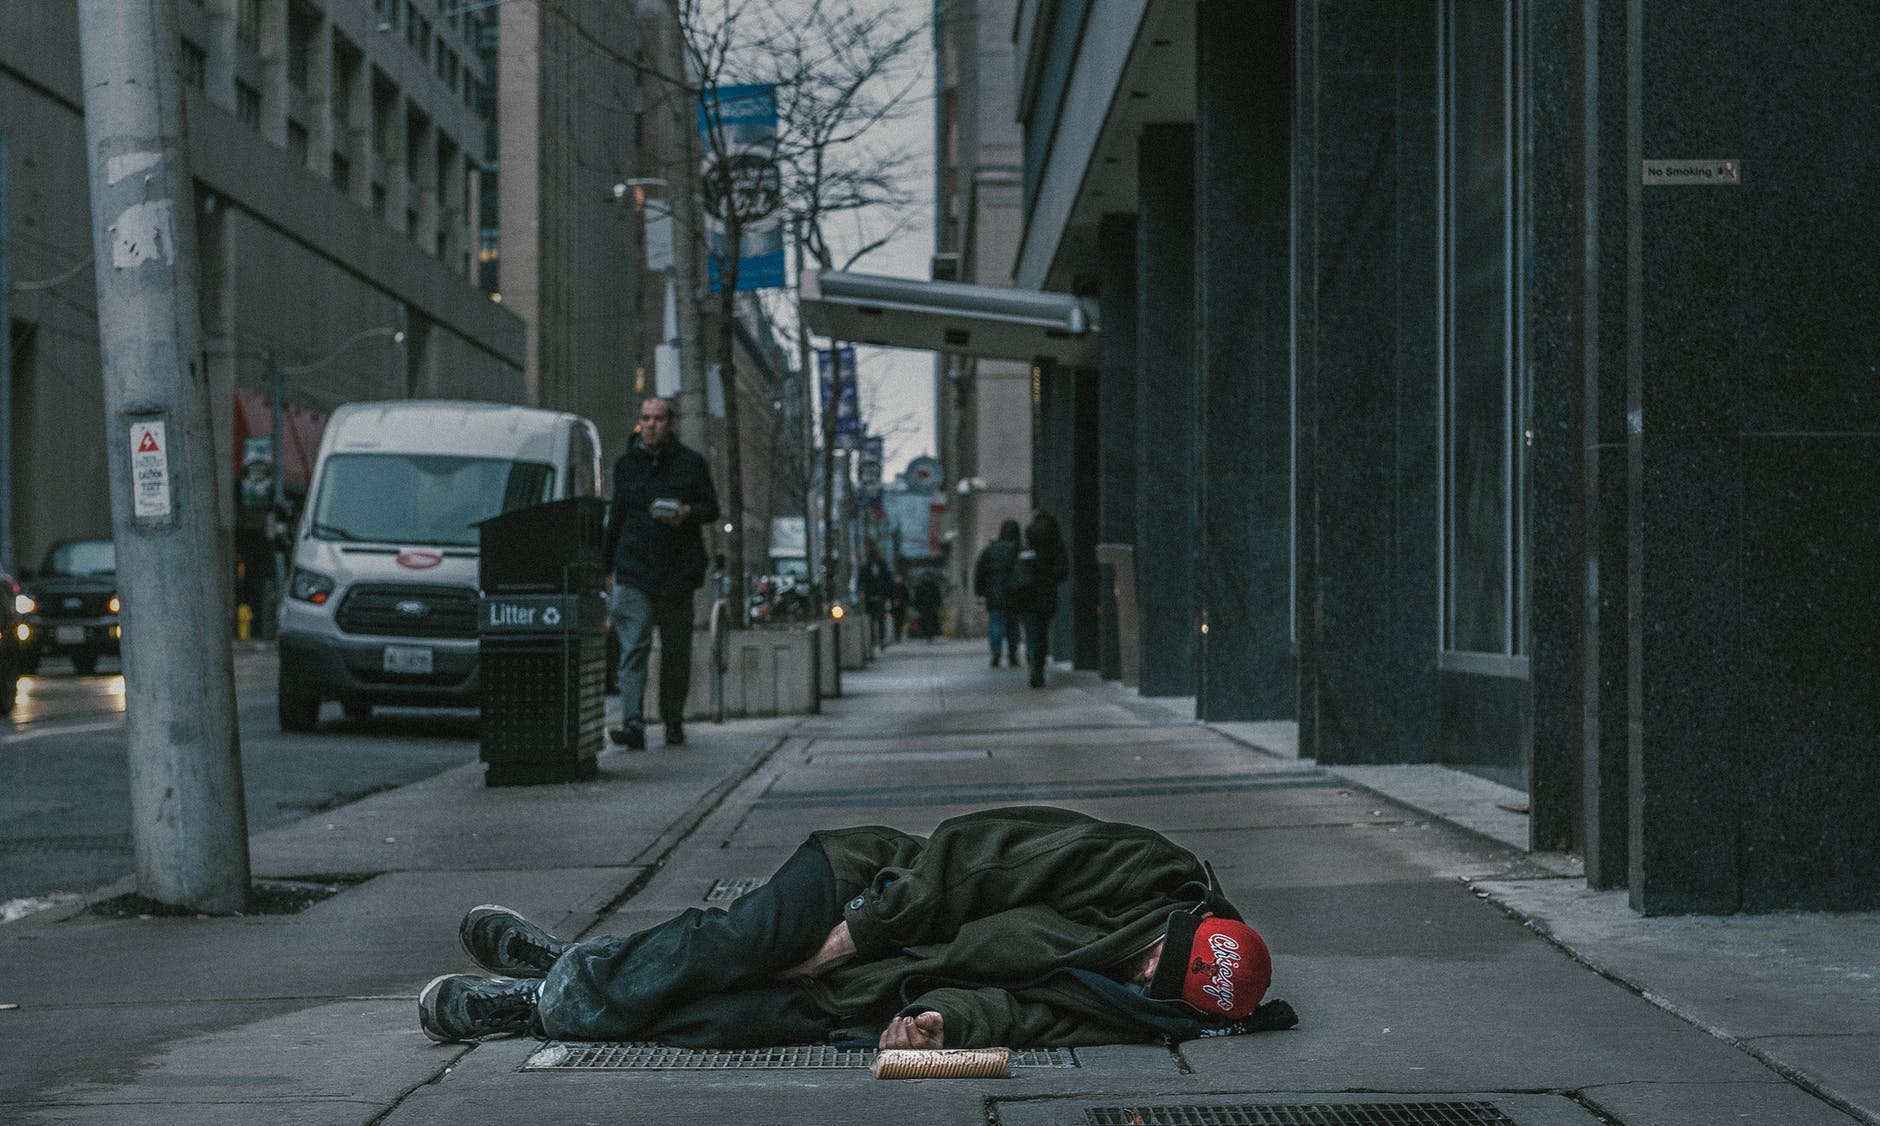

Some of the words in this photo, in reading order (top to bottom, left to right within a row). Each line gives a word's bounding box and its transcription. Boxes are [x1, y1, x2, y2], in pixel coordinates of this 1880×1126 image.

[1647, 167, 1663, 176] No
[1666, 167, 1712, 178] Smoking
[490, 603, 537, 626] Litter
[1203, 933, 1241, 1011] Chicago
